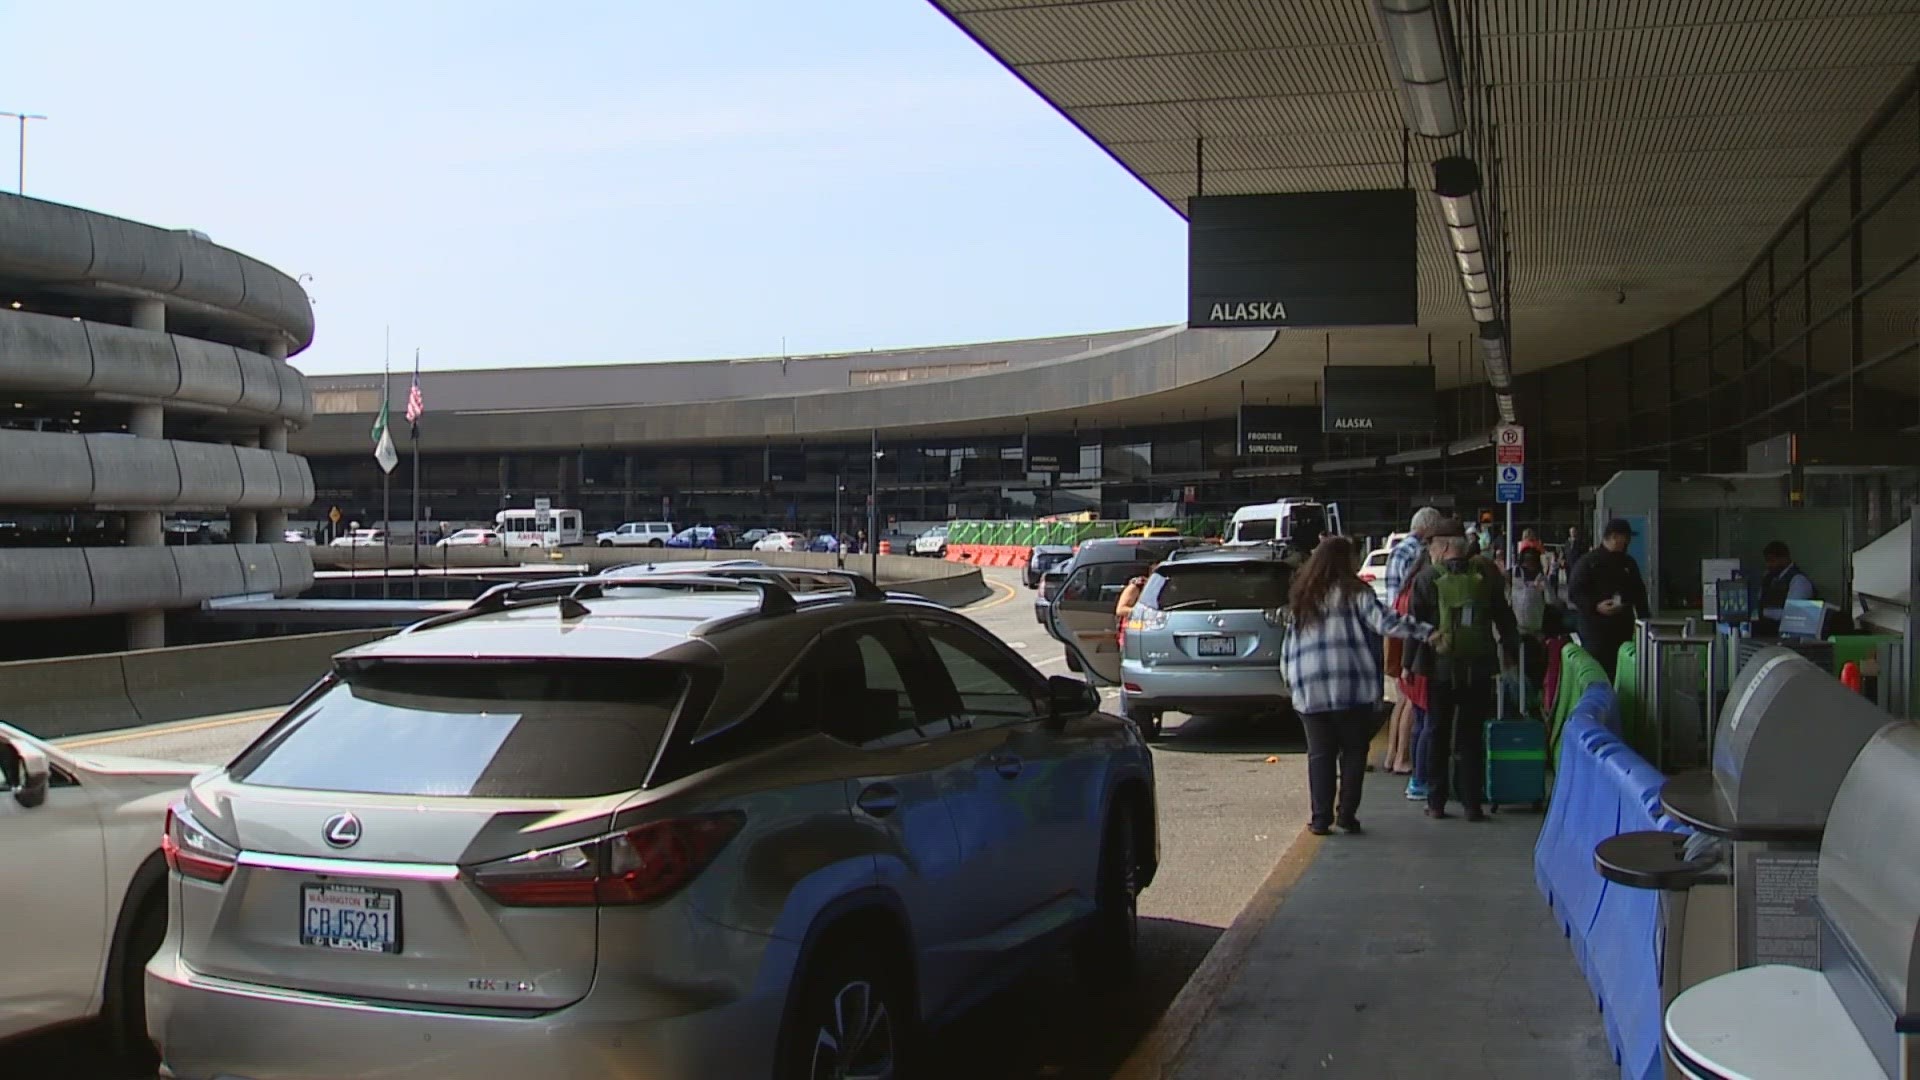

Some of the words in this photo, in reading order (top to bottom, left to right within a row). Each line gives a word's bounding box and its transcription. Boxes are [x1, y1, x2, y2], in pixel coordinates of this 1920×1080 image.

[1209, 302, 1287, 320] ALASKA
[1335, 418, 1373, 429] ALASKA
[1247, 432, 1283, 441] FRONTIER
[1248, 444, 1264, 453] SUN
[1265, 444, 1298, 453] COUNTRY
[308, 893, 362, 906] WASHINGTON
[307, 907, 390, 943] CBJ5231
[328, 936, 384, 952] LEXUS
